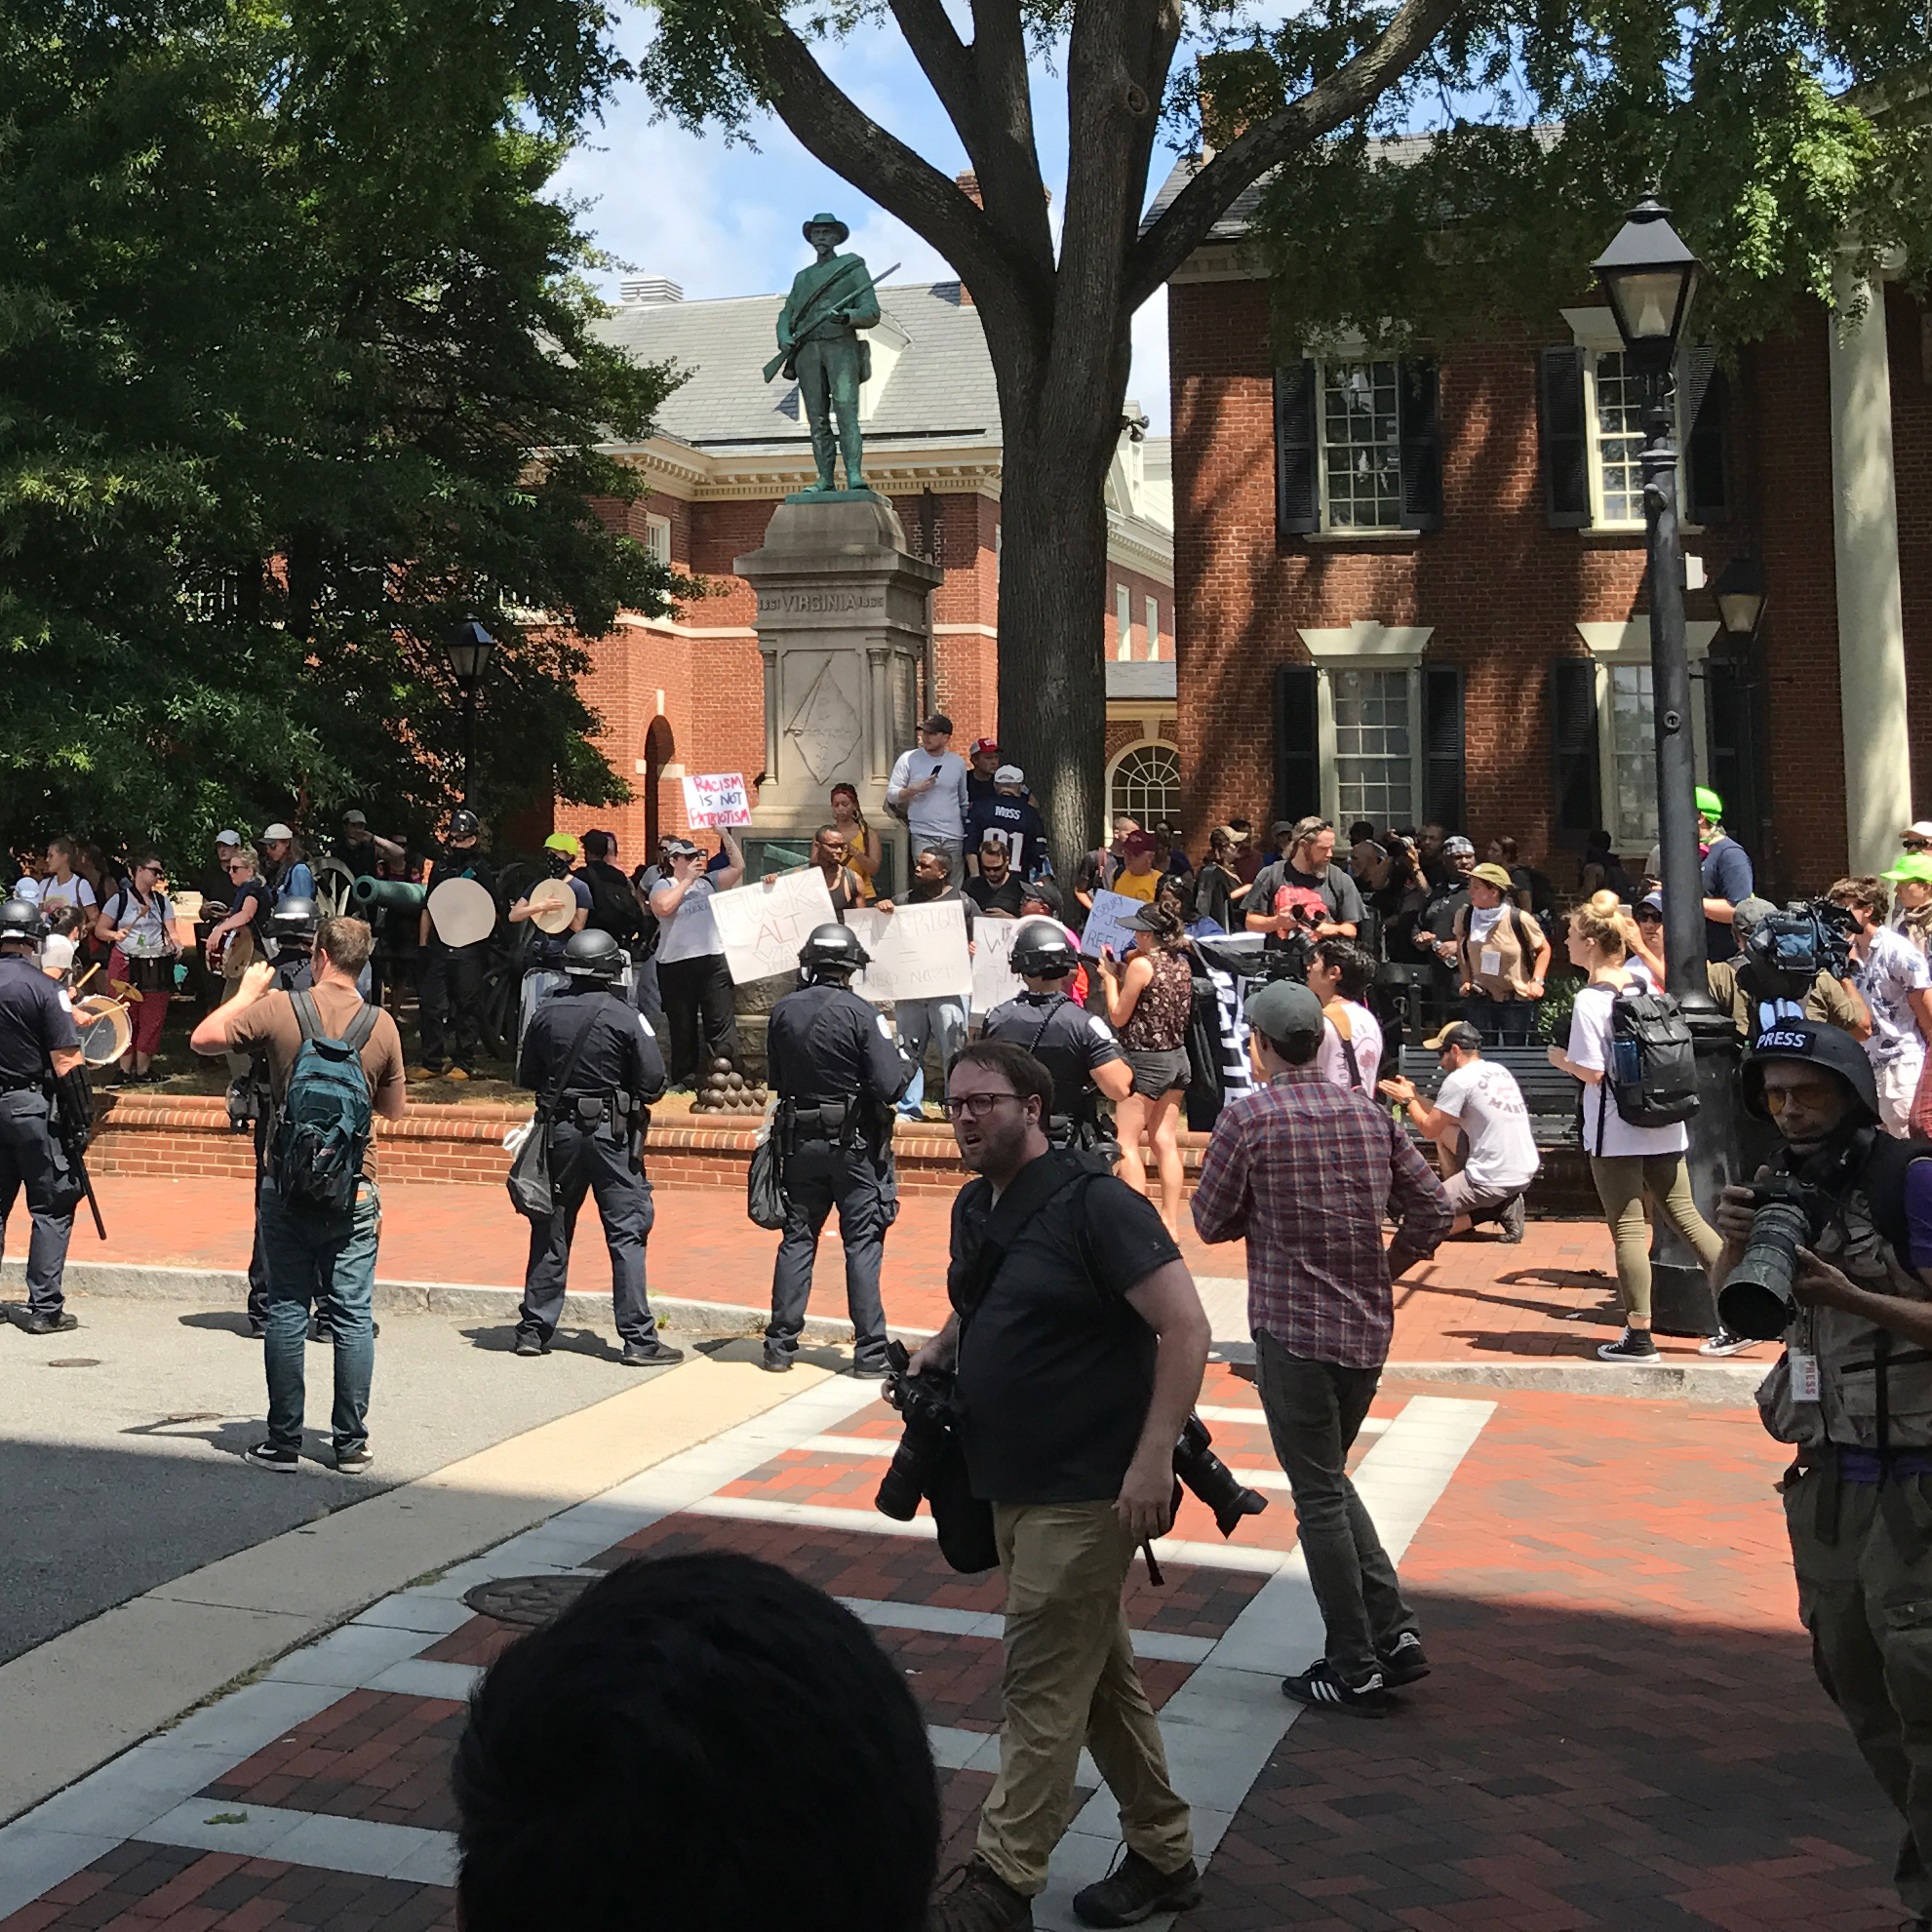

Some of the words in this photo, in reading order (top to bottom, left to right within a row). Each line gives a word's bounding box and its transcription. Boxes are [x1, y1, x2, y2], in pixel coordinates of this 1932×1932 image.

[781, 594, 857, 612] VIRGINIA
[692, 775, 744, 793] RACISM
[698, 794, 713, 807] IS
[720, 791, 742, 806] NOT
[689, 808, 751, 827] PATRIOTISM
[995, 806, 1021, 820] MOSS
[714, 872, 819, 933] FUCK
[755, 912, 803, 950] ALT
[1755, 1031, 1806, 1049] PRESS
[1805, 1360, 1816, 1395] PRESS
